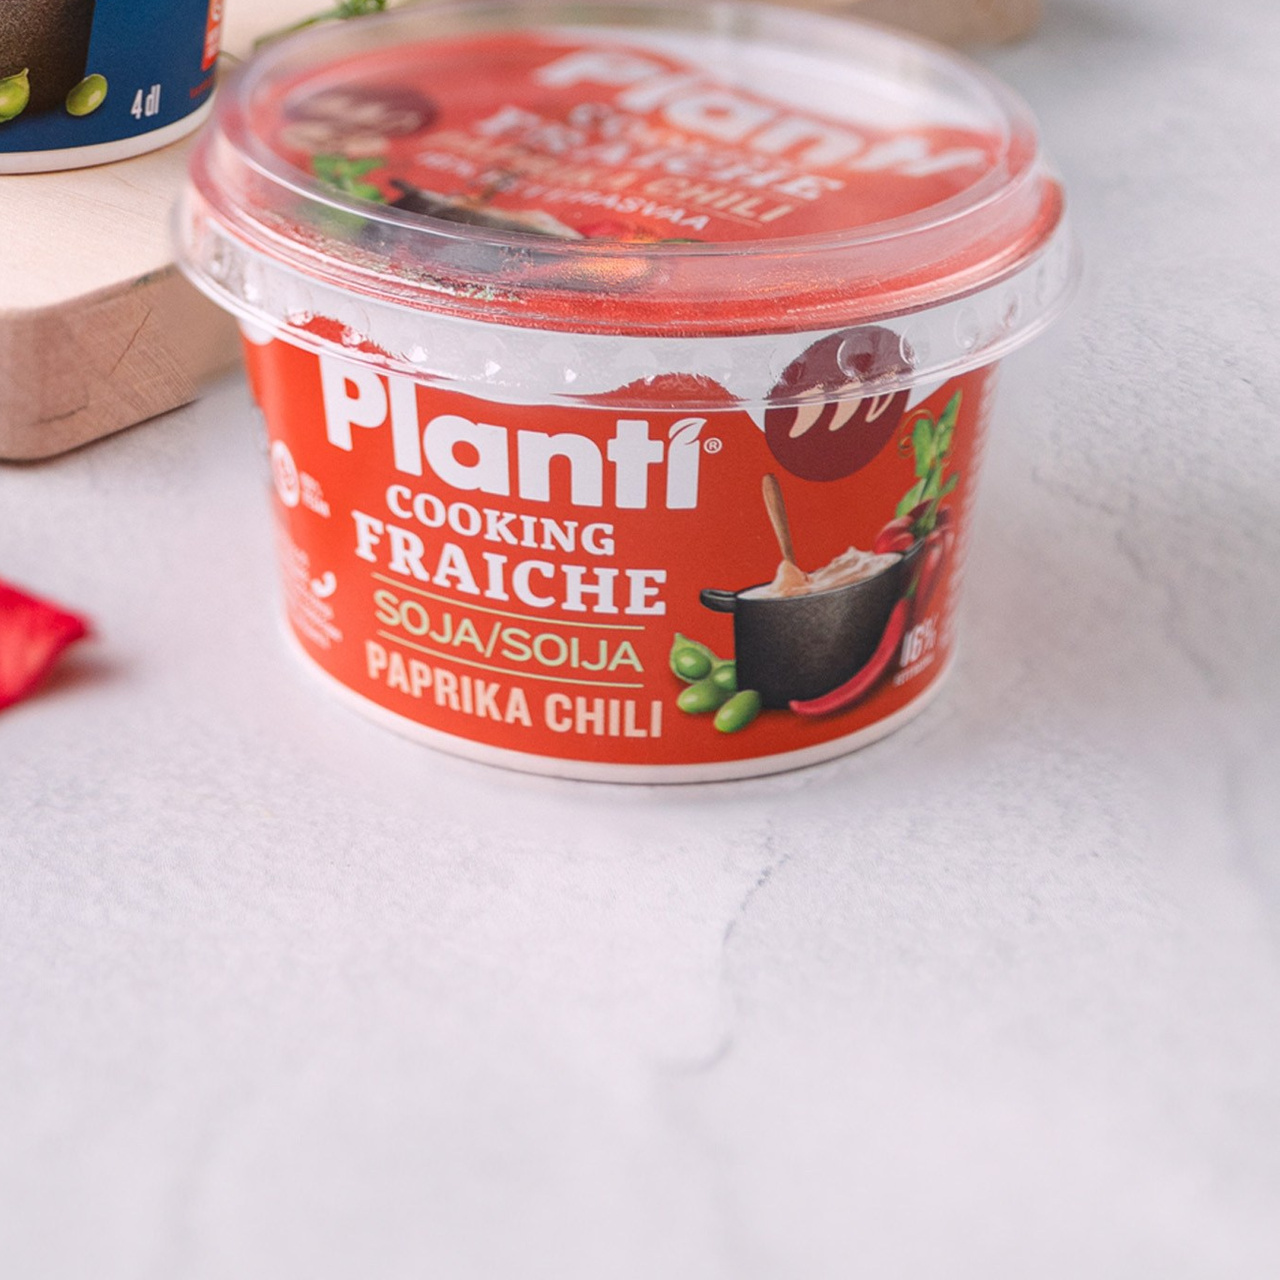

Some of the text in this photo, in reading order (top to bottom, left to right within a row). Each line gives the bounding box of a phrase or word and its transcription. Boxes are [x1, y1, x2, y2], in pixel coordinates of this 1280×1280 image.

[129, 88, 143, 120] 4
[145, 83, 161, 117] dl
[385, 484, 615, 556] COOKING
[350, 510, 667, 616] FRAICHE
[373, 590, 644, 673] SOJA/SOIJA
[364, 639, 663, 739] PAPRIKA CHILI
